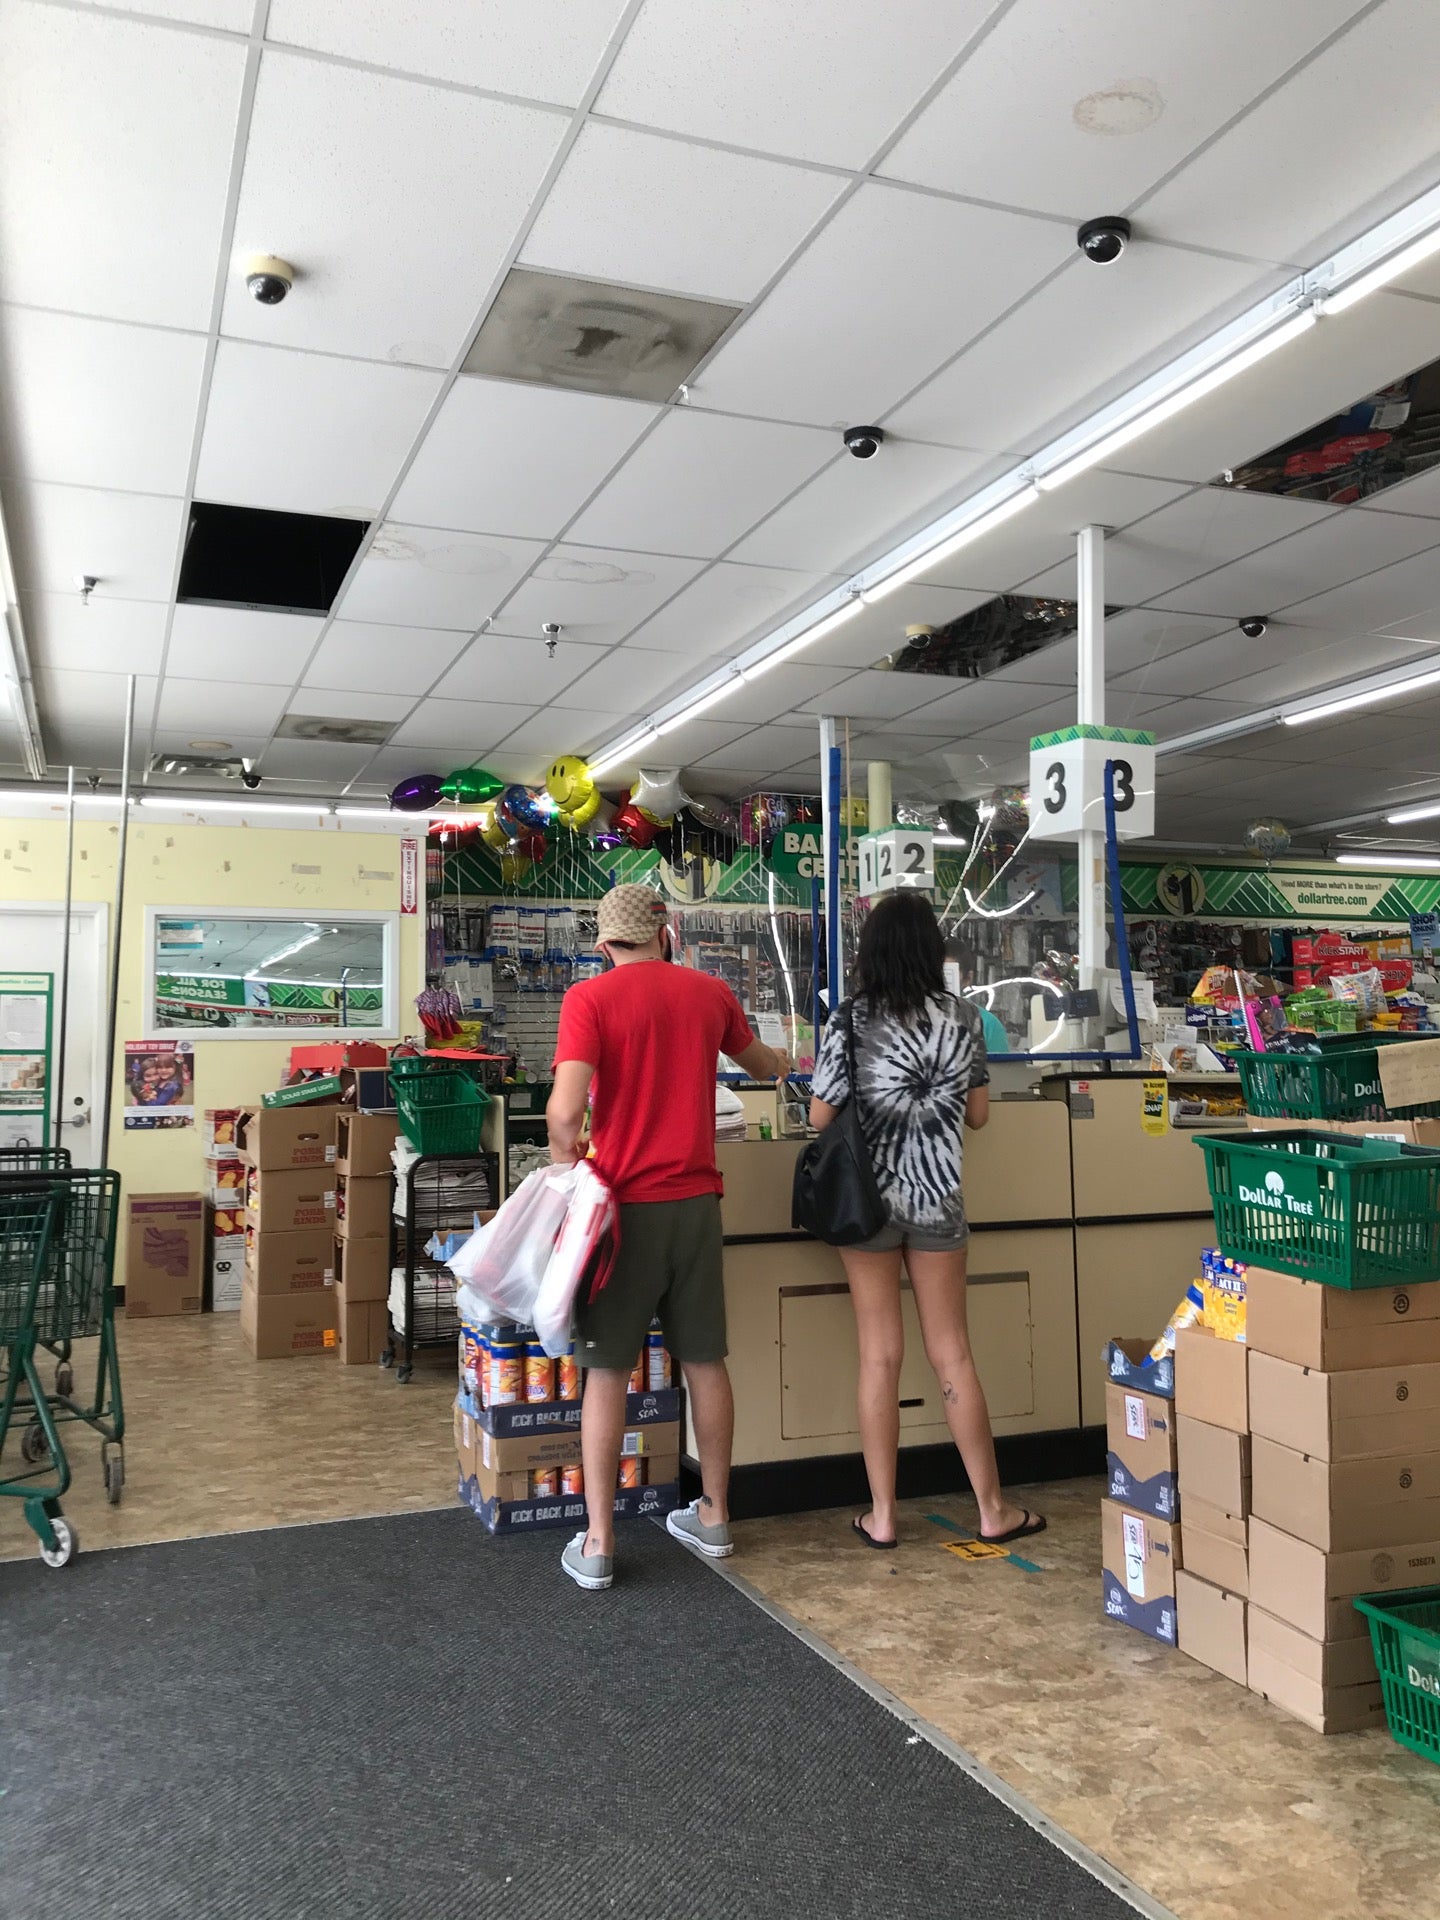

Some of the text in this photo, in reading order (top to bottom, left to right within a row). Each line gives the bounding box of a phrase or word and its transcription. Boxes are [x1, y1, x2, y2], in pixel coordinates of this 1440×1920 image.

[1044, 762, 1067, 814] 3
[1110, 759, 1135, 812] 3
[881, 845, 891, 877] 2
[903, 843, 925, 874] 2
[865, 853, 872, 882] 1
[1280, 880, 1295, 888] Need
[1329, 882, 1347, 890] what's
[1298, 892, 1368, 906] dollartree.com
[1412, 914, 1435, 925] SHOP
[1318, 945, 1365, 956] KICKSTART
[1144, 1103, 1162, 1113] SNAP
[293, 1216, 327, 1225] RINDS
[1218, 1278, 1232, 1290] ACT
[511, 1415, 533, 1428] KICK
[536, 1412, 561, 1426] BACK
[511, 1509, 533, 1524] KICK
[536, 1506, 562, 1521] BACK
[564, 1503, 583, 1518] AND
